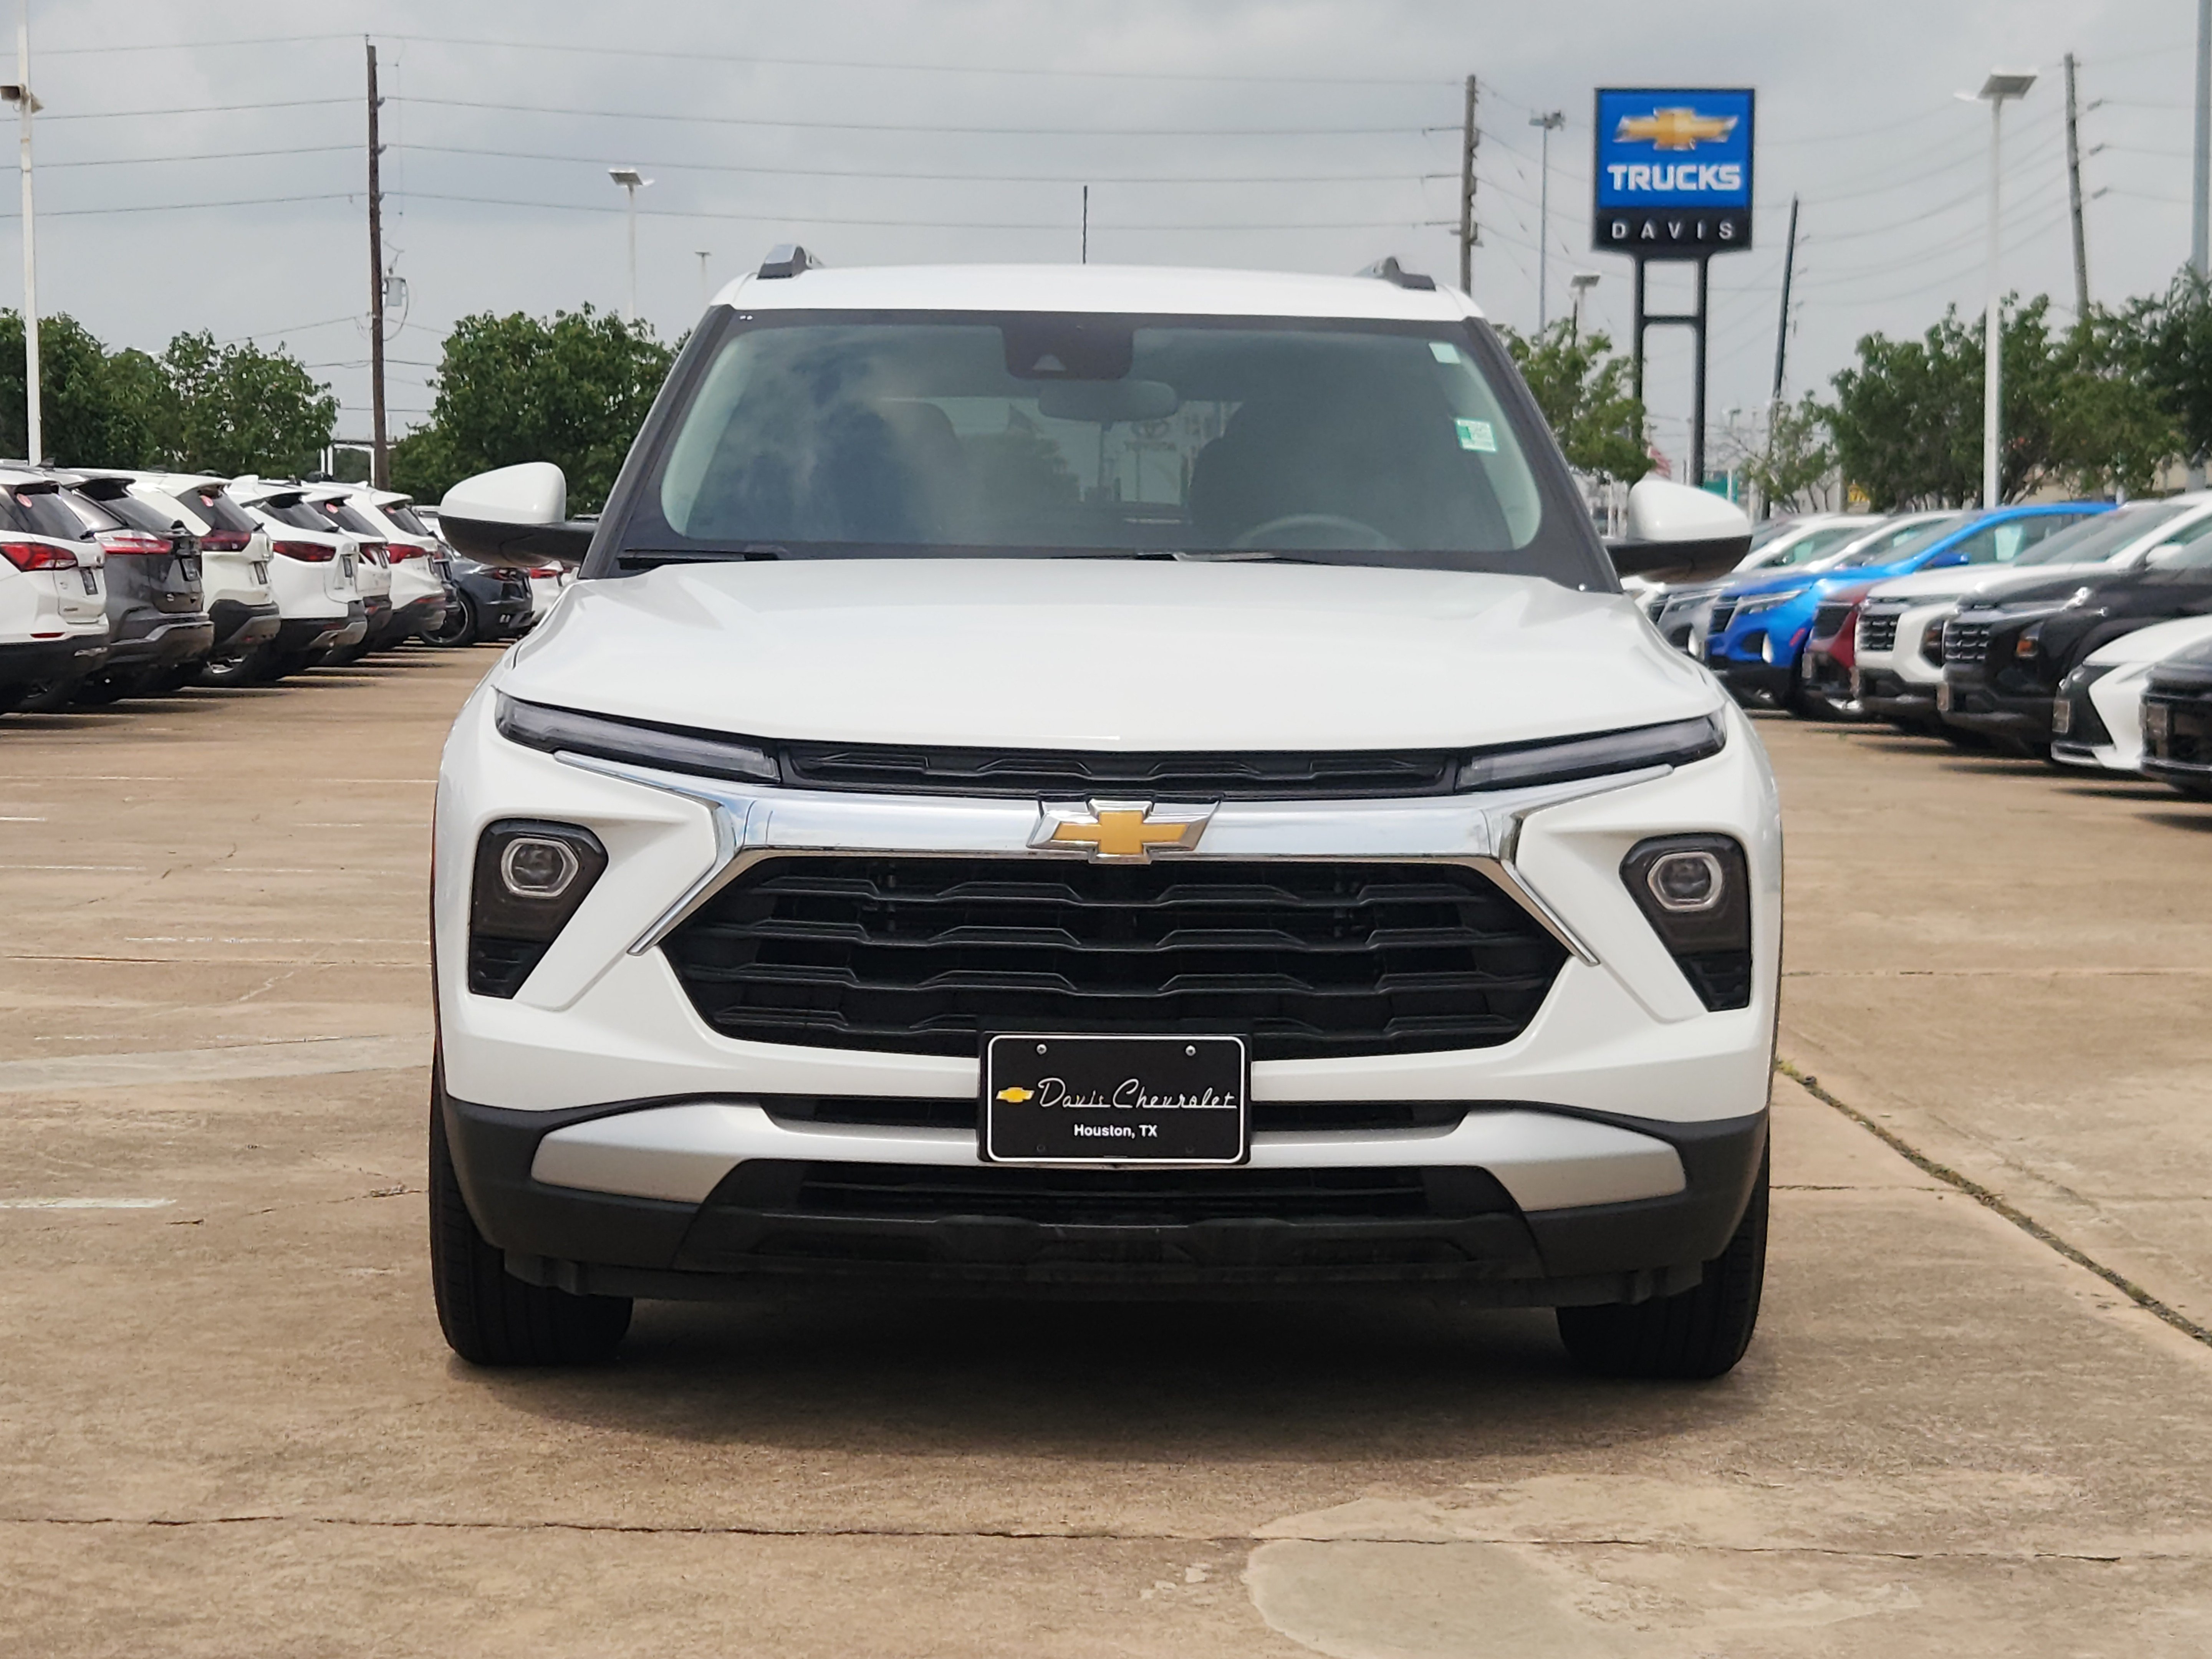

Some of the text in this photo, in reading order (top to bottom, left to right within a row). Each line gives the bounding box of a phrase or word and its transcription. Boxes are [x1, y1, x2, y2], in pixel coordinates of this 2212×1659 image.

[1607, 165, 1741, 191] TRUCKS
[1612, 220, 1733, 239] DAVIS
[1038, 1078, 1237, 1109] Davis Chevrolet
[1074, 1124, 1157, 1139] Houston, TX
